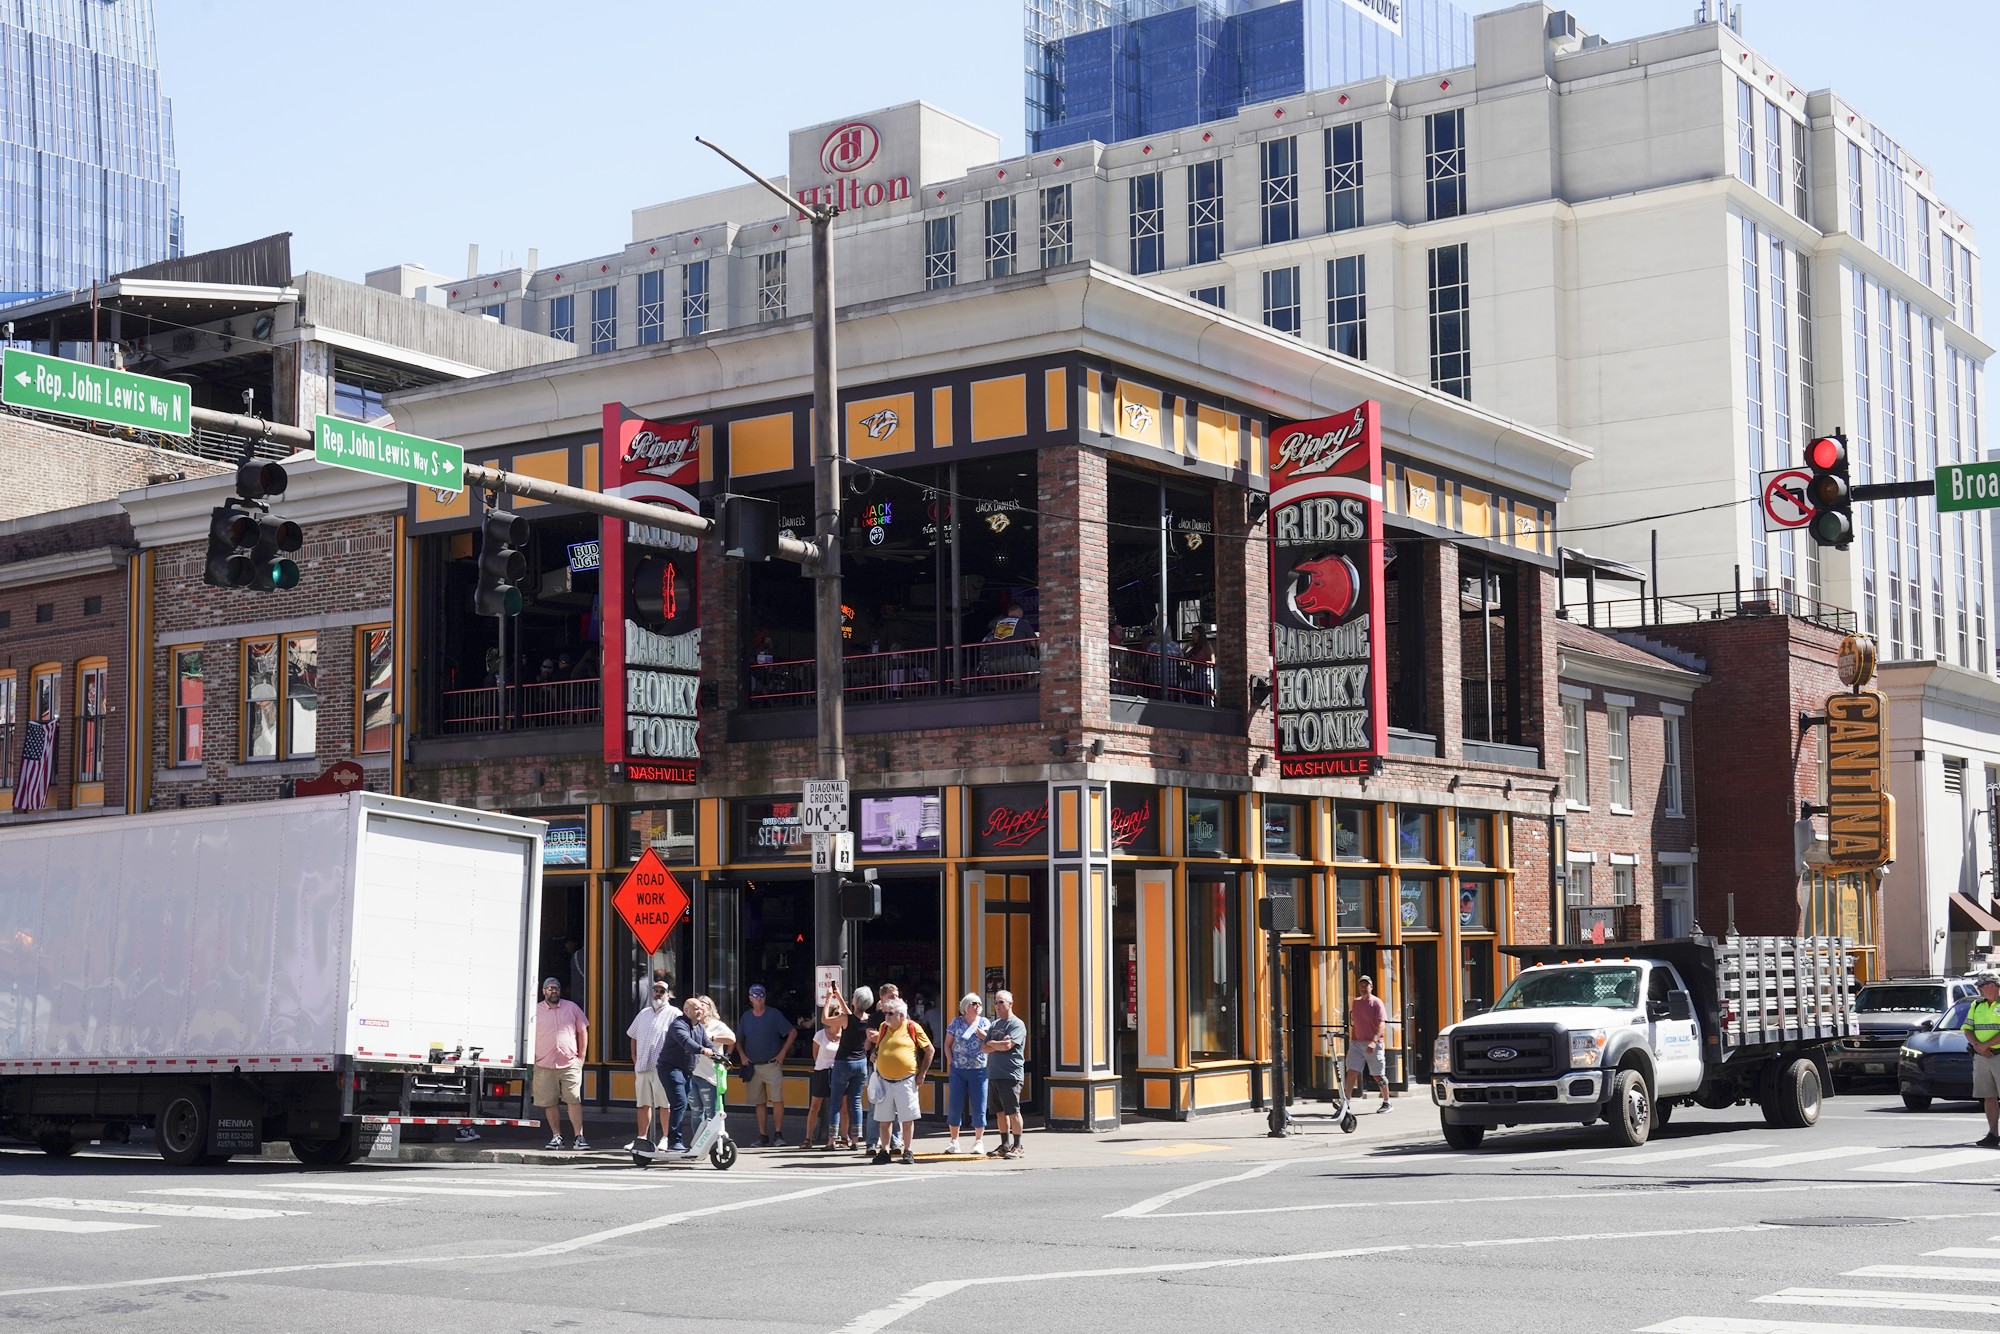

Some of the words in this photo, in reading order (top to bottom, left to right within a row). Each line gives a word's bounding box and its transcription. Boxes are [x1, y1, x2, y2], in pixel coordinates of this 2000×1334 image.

[796, 176, 911, 221] Hilton
[36, 364, 66, 402] Rep.
[68, 371, 102, 404] John
[105, 378, 145, 412] Lewis
[150, 394, 168, 421] Way
[172, 394, 182, 422] N
[624, 426, 699, 467] Rippy's
[1270, 407, 1365, 471] Rippy's
[323, 424, 347, 458] Rep.
[348, 430, 375, 459] John
[378, 436, 410, 467] Lewis
[413, 451, 429, 476] Way
[431, 450, 439, 476] S
[1951, 467, 1999, 500] Broa
[862, 502, 892, 519] JACK
[1276, 496, 1364, 546] RIBS
[574, 543, 599, 558] BUD
[572, 554, 600, 569] LIGH
[625, 619, 701, 670] BARBEQUE
[1274, 613, 1370, 665] BARBEQUE
[627, 669, 699, 717] HONKY
[1277, 664, 1369, 711] HONKY
[628, 715, 699, 758] TONK
[1278, 710, 1369, 753] TONK
[628, 765, 696, 782] NASHVILLE
[1282, 759, 1369, 777] NASHVILLE
[1828, 697, 1880, 855] CANTINA
[810, 783, 844, 793] DIAGONAL
[810, 794, 844, 803] CROSSING
[805, 808, 823, 826] OK
[982, 800, 1048, 836] Rippy's
[550, 831, 576, 843] BUD
[758, 826, 802, 846] SELTZER
[636, 873, 665, 886] ROAD
[636, 892, 665, 906] WORK
[634, 912, 670, 925] AHEAD
[1493, 1050, 1510, 1058] Ford
[218, 1119, 254, 1128] HENNA
[360, 1123, 392, 1132] HENNA
[376, 1142, 392, 1151] TEXAS
